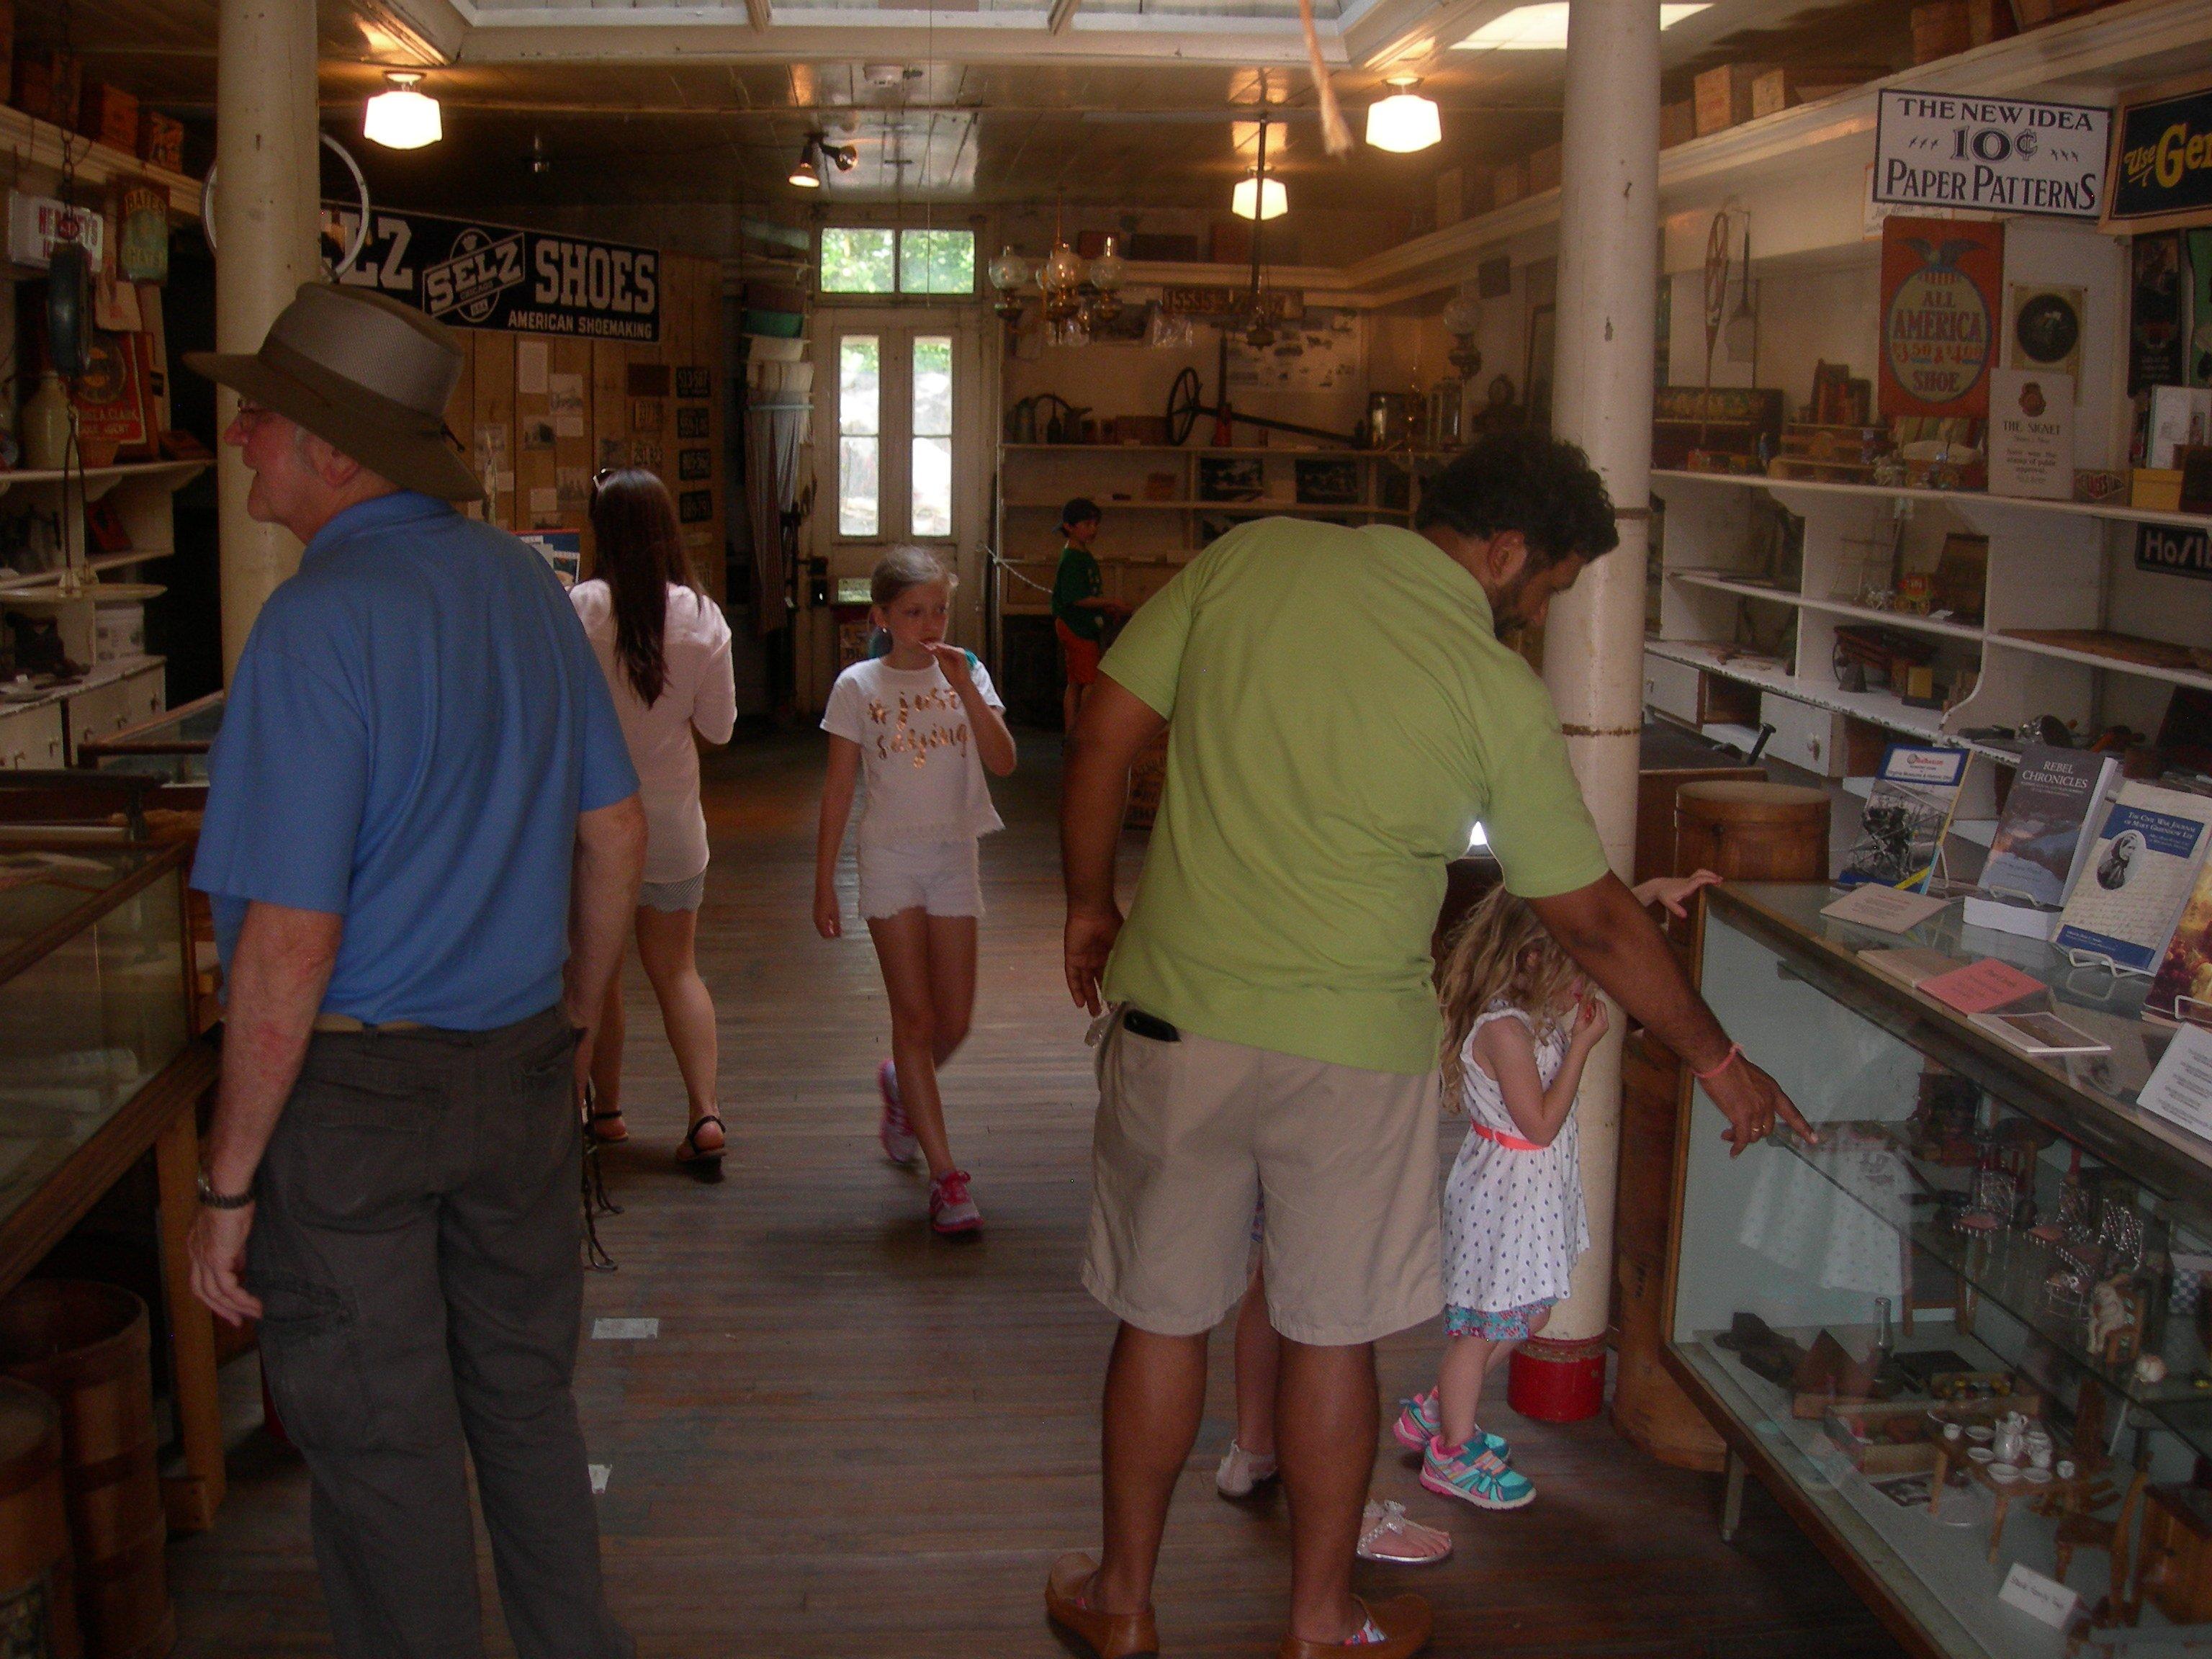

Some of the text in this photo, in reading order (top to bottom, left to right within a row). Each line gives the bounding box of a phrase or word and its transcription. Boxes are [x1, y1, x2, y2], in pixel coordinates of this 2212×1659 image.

[1897, 97, 2094, 132] THE NEW IDEA
[1885, 157, 2097, 210] PAPER PATTERNS
[321, 210, 656, 315] LZ SHOES
[426, 241, 521, 313] SELZ
[1923, 289, 1956, 308] ALL
[507, 309, 653, 339] AMERICAN SHOEMAKING
[1893, 310, 1983, 343] AMERICA
[1912, 370, 1961, 392] SHOE
[2003, 420, 2061, 436] THE SIGNET
[2021, 769, 2089, 788] CHRONICLES
[2043, 760, 2074, 775] REBEL
